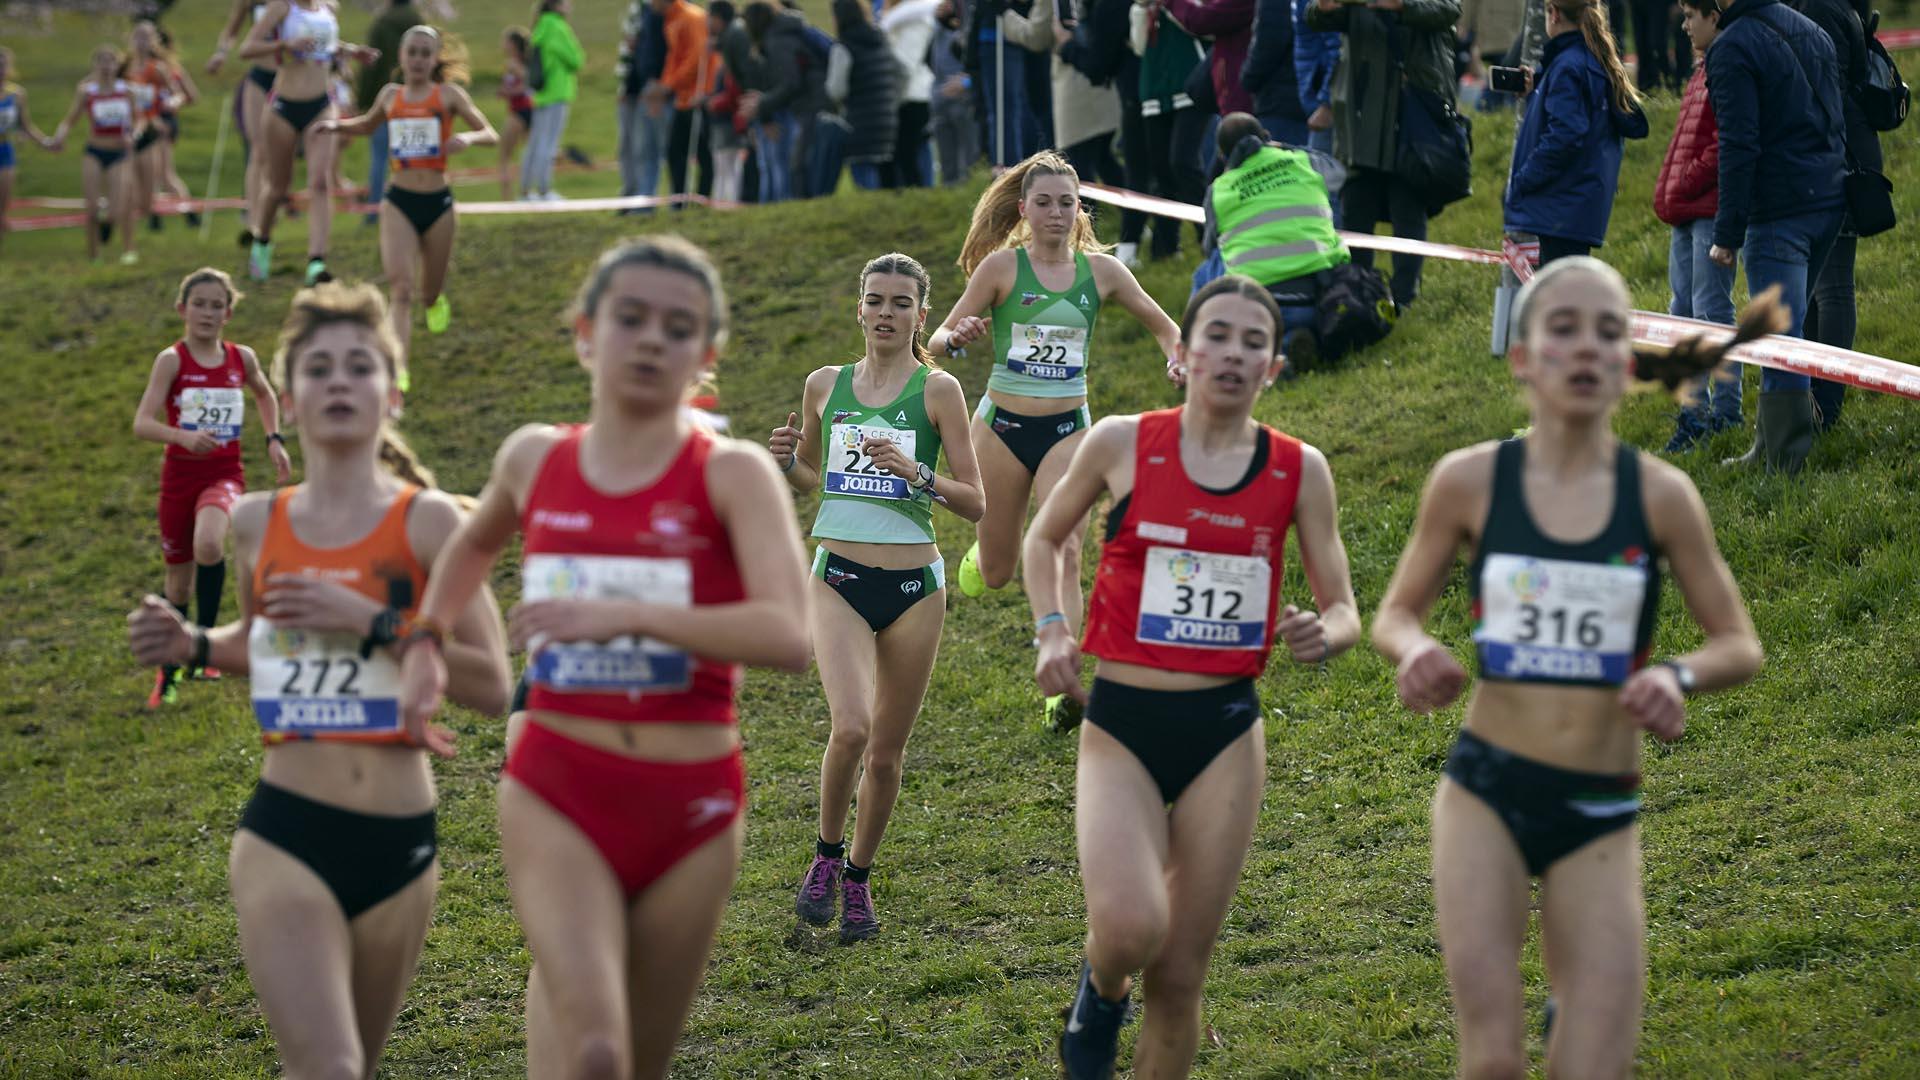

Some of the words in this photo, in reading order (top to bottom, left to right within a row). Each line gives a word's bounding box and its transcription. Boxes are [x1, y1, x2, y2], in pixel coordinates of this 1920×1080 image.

[1025, 344, 1067, 365] 222
[197, 406, 232, 424] 297
[844, 449, 894, 477] 22
[840, 475, 895, 494] Joma
[1172, 584, 1243, 620] 312
[1165, 619, 1242, 642] Joma
[1516, 602, 1604, 649] 316
[281, 658, 362, 695] 272
